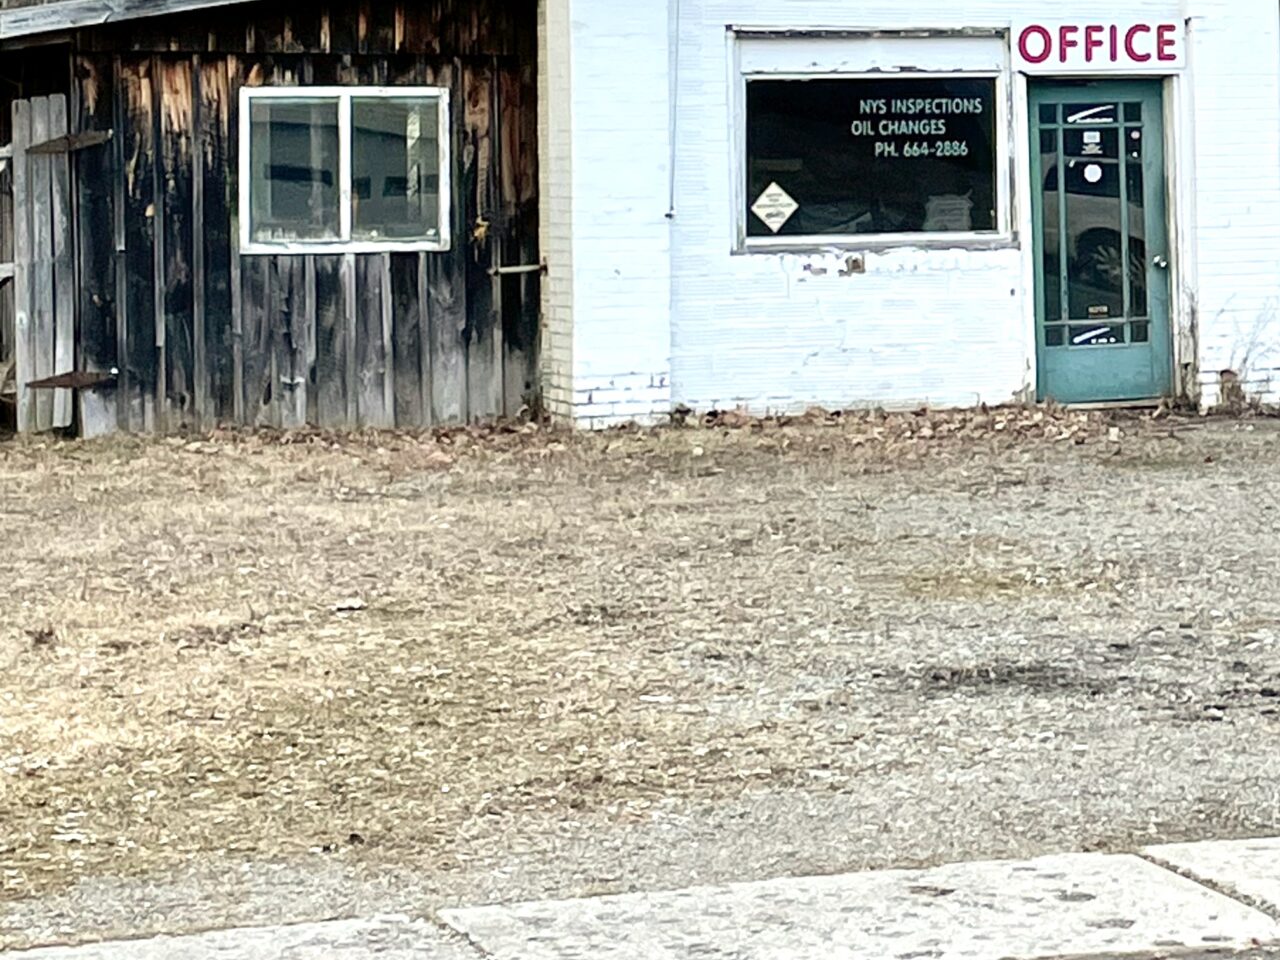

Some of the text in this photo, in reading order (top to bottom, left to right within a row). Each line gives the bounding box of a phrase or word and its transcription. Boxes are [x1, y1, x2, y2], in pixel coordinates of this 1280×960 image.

[1018, 24, 1177, 63] OFFICE
[860, 98, 982, 114] NYS INSPECTIONS
[851, 119, 946, 136] OIL CHANGES
[874, 140, 969, 157] PH. 664-2886
